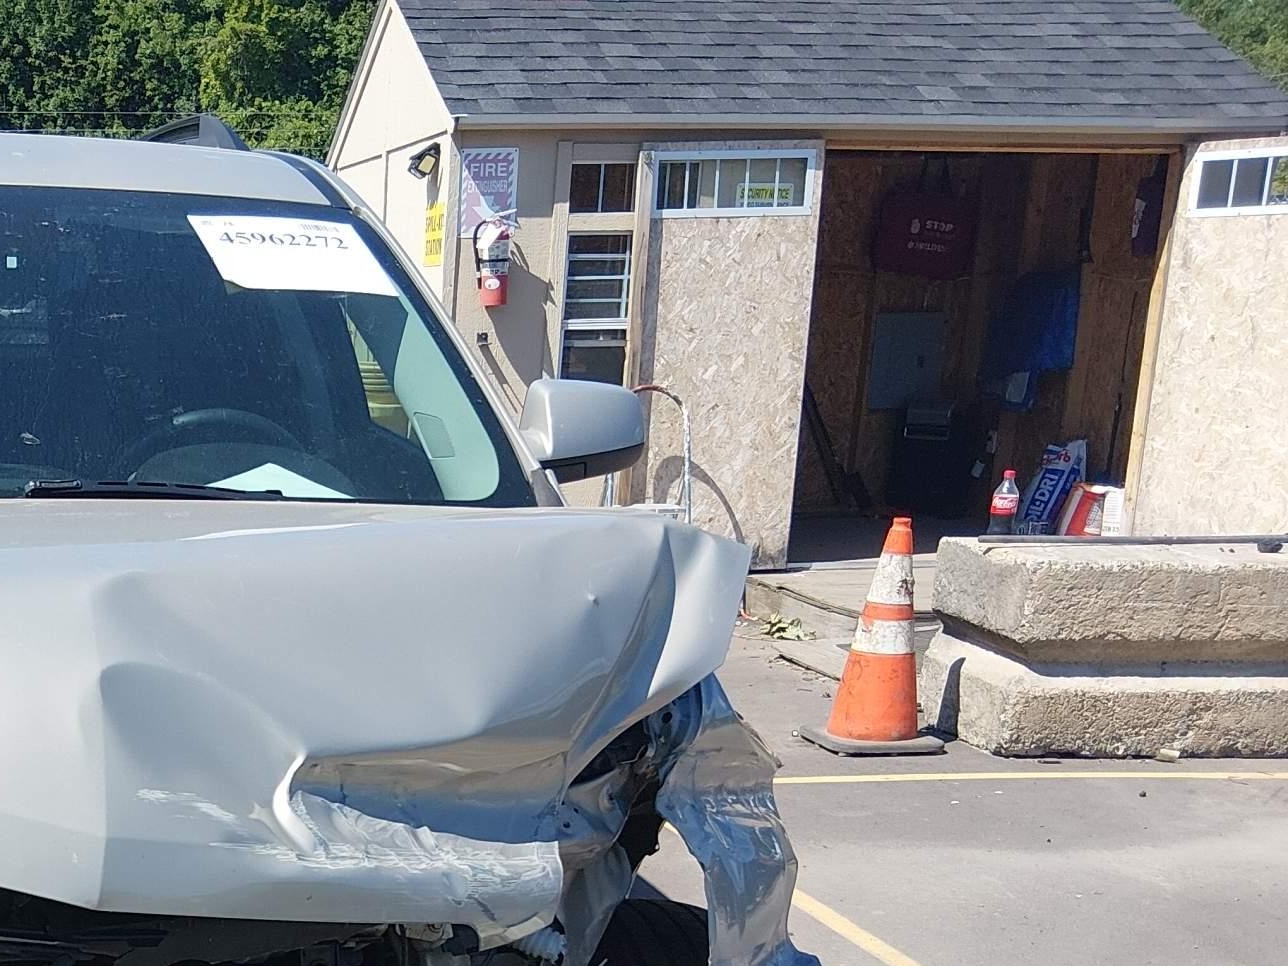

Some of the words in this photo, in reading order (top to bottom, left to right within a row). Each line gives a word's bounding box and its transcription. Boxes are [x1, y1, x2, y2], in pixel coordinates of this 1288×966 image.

[469, 162, 508, 177] FIRE
[467, 180, 508, 193] EXTINGUISHER
[740, 188, 770, 200] SCURITY
[768, 187, 790, 199] NTICE
[925, 220, 954, 233] STOP
[219, 231, 349, 250] 45962272
